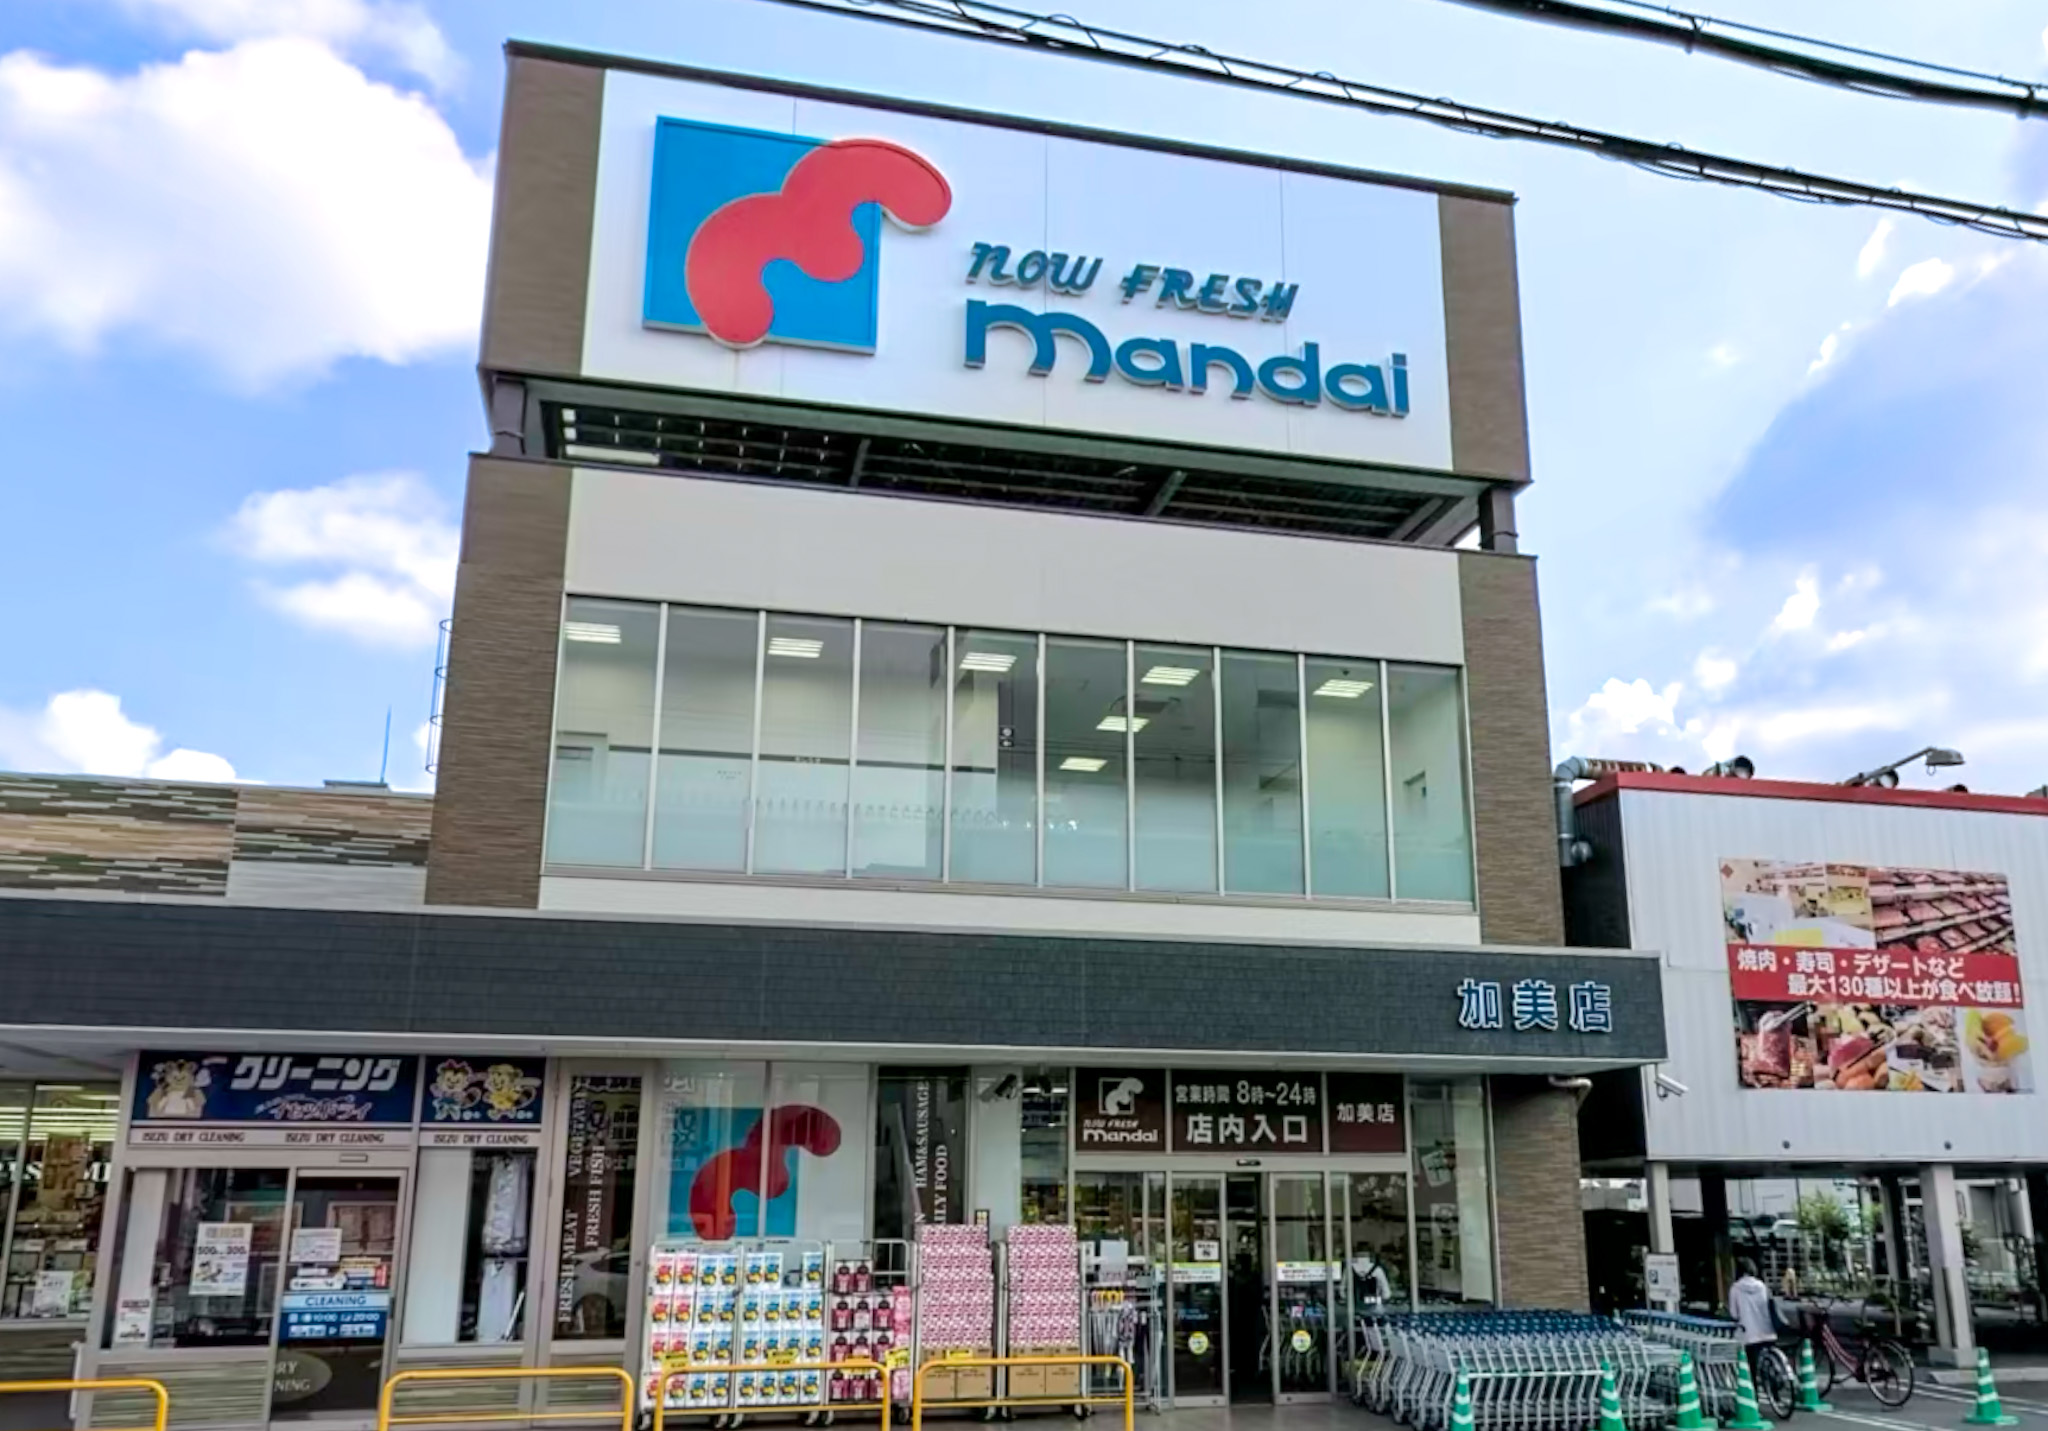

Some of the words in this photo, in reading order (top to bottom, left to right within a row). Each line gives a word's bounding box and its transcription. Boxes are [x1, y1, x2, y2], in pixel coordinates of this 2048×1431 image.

[1119, 262, 1300, 323] FRESH
[964, 297, 1410, 418] mandai
[1457, 978, 1613, 1033] 加美店
[230, 1056, 402, 1092] クリーニング
[1174, 1083, 1231, 1104] 営業時間
[1186, 1112, 1308, 1144] 店内入口
[1336, 1101, 1396, 1124] 加美店
[174, 1132, 195, 1142] DRY
[199, 1132, 246, 1143] CLEANING
[316, 1133, 338, 1143] DRY
[340, 1133, 385, 1144] CLEANING
[463, 1135, 482, 1144] DRY
[486, 1135, 529, 1145] CLEANING
[915, 1080, 930, 1188] HAM&SAUSAGE
[1083, 1127, 1159, 1143] mandai
[590, 1146, 606, 1185] FISH
[934, 1144, 948, 1191] FOOD
[561, 1208, 579, 1260] MEAT
[585, 1189, 603, 1247] FRESH
[305, 1296, 367, 1306] CLEANING
[558, 1263, 575, 1323] FRESH
[276, 1360, 298, 1375] RY
